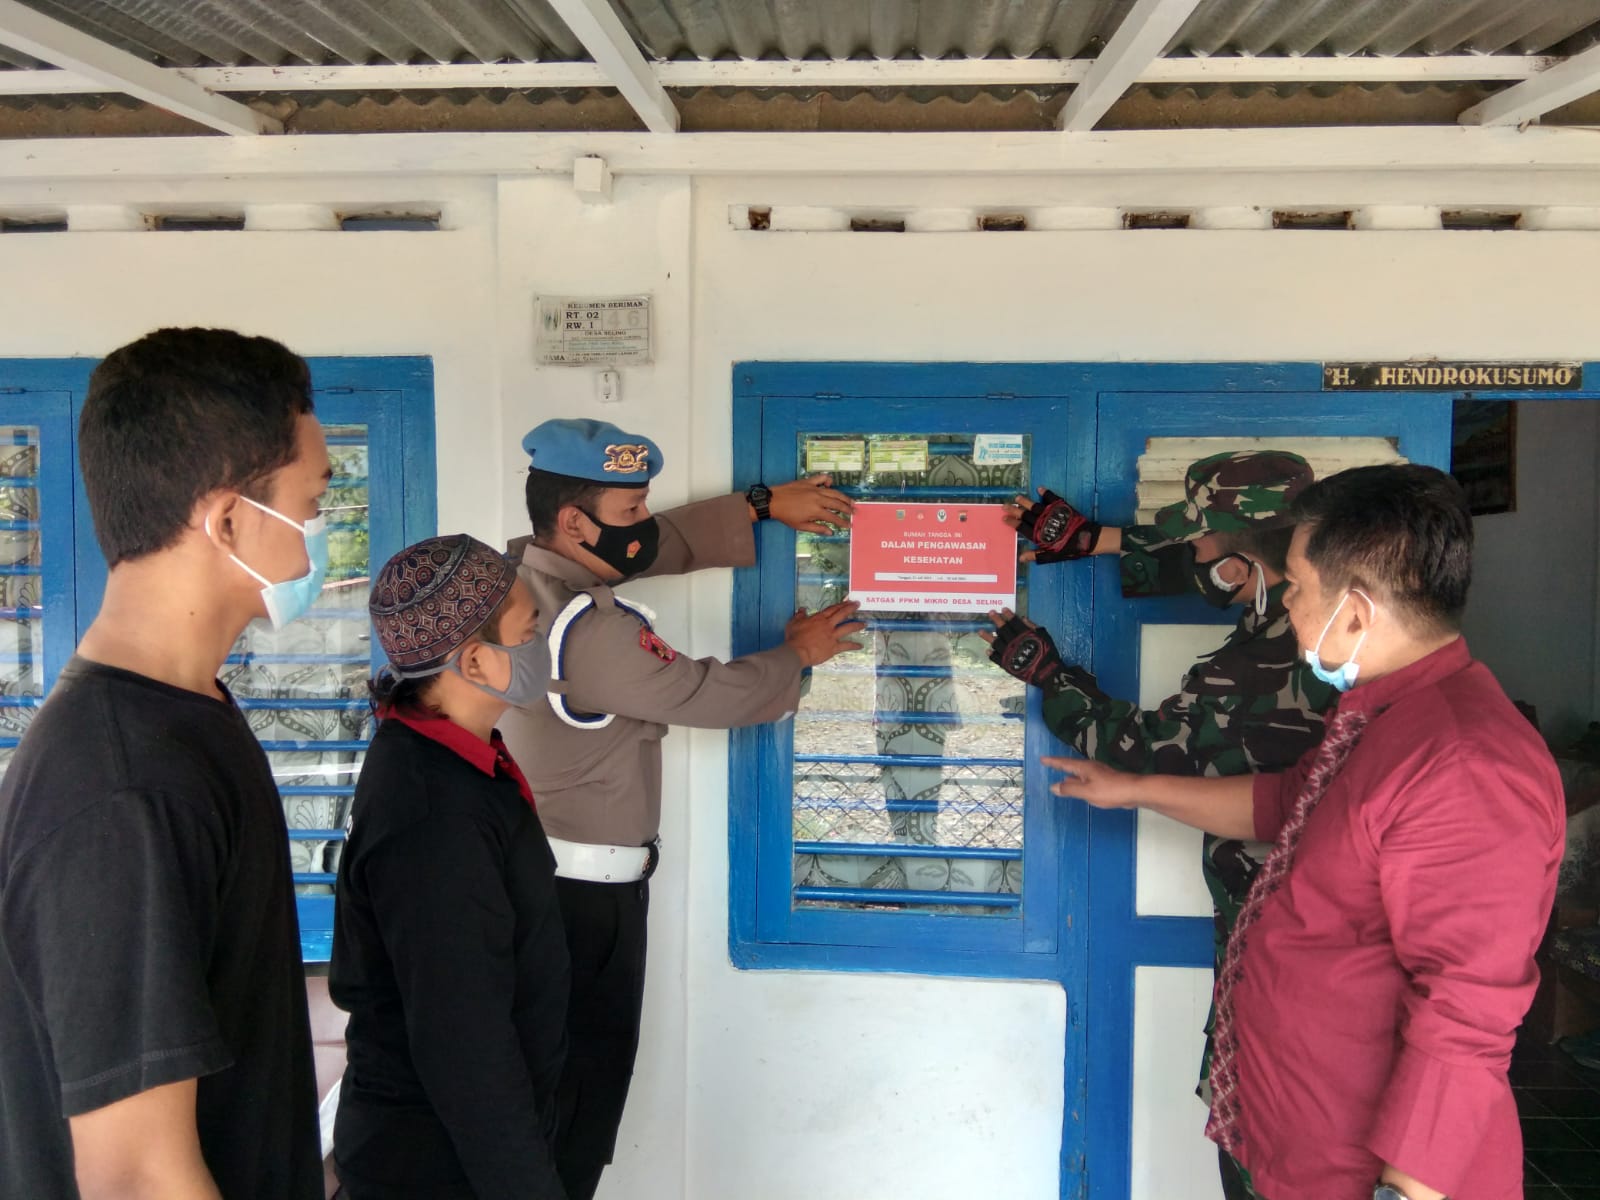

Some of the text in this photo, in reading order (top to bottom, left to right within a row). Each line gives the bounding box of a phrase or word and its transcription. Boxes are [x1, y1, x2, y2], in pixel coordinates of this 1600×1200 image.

[586, 311, 599, 319] 02
[880, 540, 987, 550] DALAM PENGAWASAN
[903, 556, 963, 565] KESEHATAN
